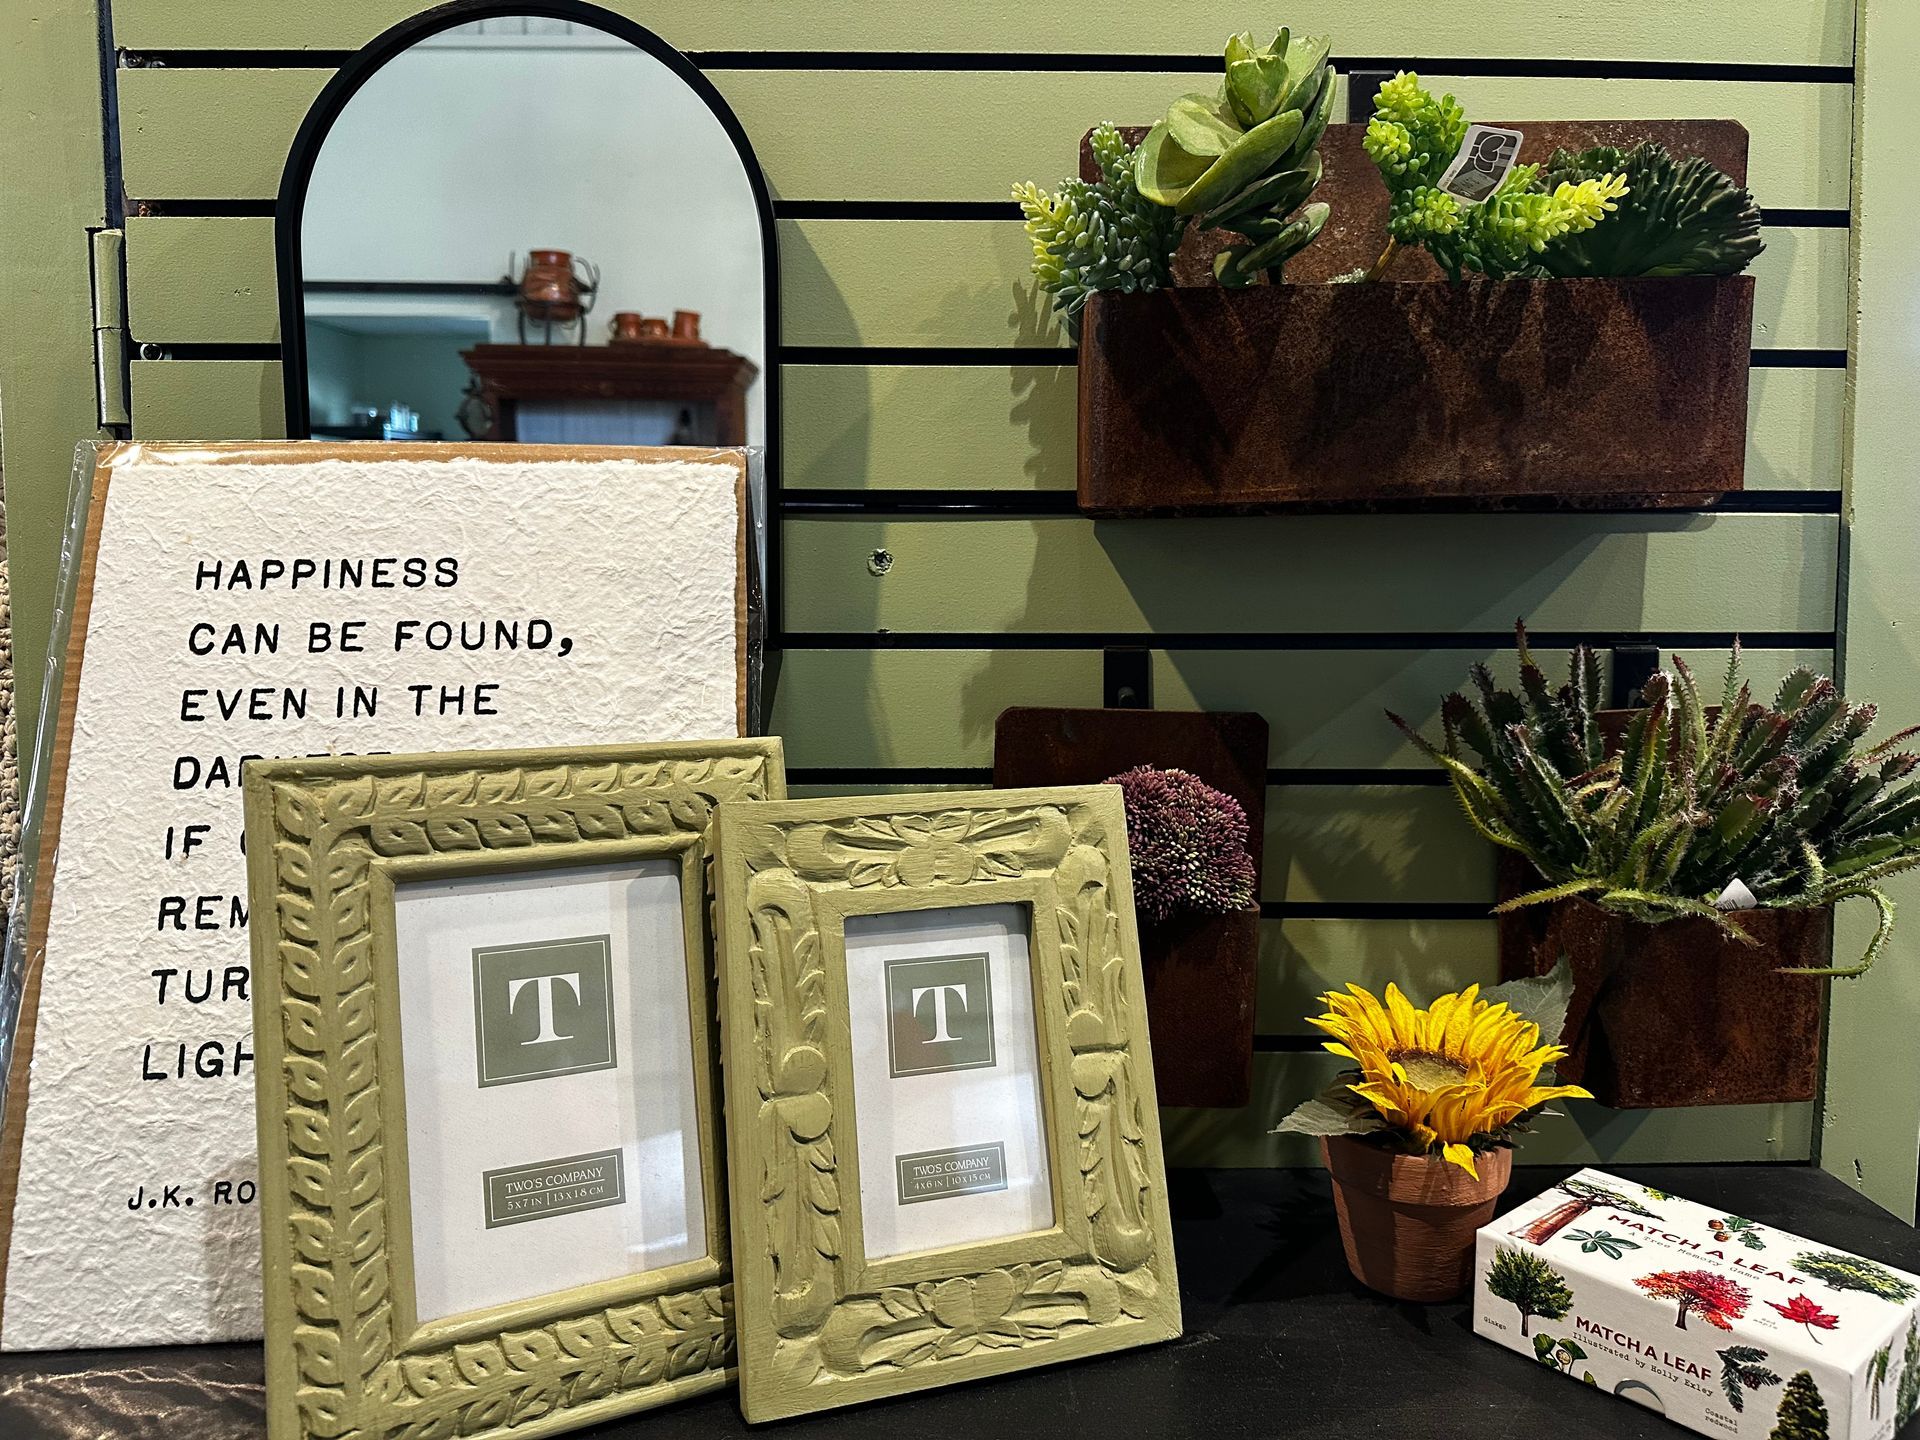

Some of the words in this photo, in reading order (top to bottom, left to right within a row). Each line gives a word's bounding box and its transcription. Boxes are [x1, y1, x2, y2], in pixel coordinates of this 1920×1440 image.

[196, 558, 458, 590] HAPPINESS
[189, 623, 280, 655] CAN
[308, 621, 366, 653] BE
[395, 619, 573, 657] FOUND,
[180, 688, 307, 721] EVEN
[336, 687, 378, 718] IN
[408, 684, 500, 716] THE
[166, 825, 211, 859] IF
[152, 966, 250, 1004] TUR
[508, 972, 581, 1045] T
[912, 983, 968, 1044] T
[505, 1177, 543, 1193] TWO'S
[545, 1166, 604, 1187] COMPANY
[944, 1156, 990, 1172] COMPANY
[128, 1186, 194, 1211] J.K.
[1608, 1214, 1702, 1250] MATCH
[1705, 1250, 1724, 1260] A
[1733, 1257, 1806, 1285] LEAF
[1643, 1236, 1671, 1249] Tree
[1677, 1248, 1724, 1267] Memory
[1728, 1266, 1760, 1280] Game
[1573, 1332, 1630, 1361] Illustrated
[1634, 1357, 1646, 1369] by
[1650, 1365, 1679, 1383] Holly
[1684, 1379, 1714, 1397] Exley
[1576, 1316, 1641, 1353] MATCH
[1644, 1345, 1658, 1361] A
[1663, 1352, 1712, 1381] LEAF
[1705, 1407, 1738, 1427] Coastal
